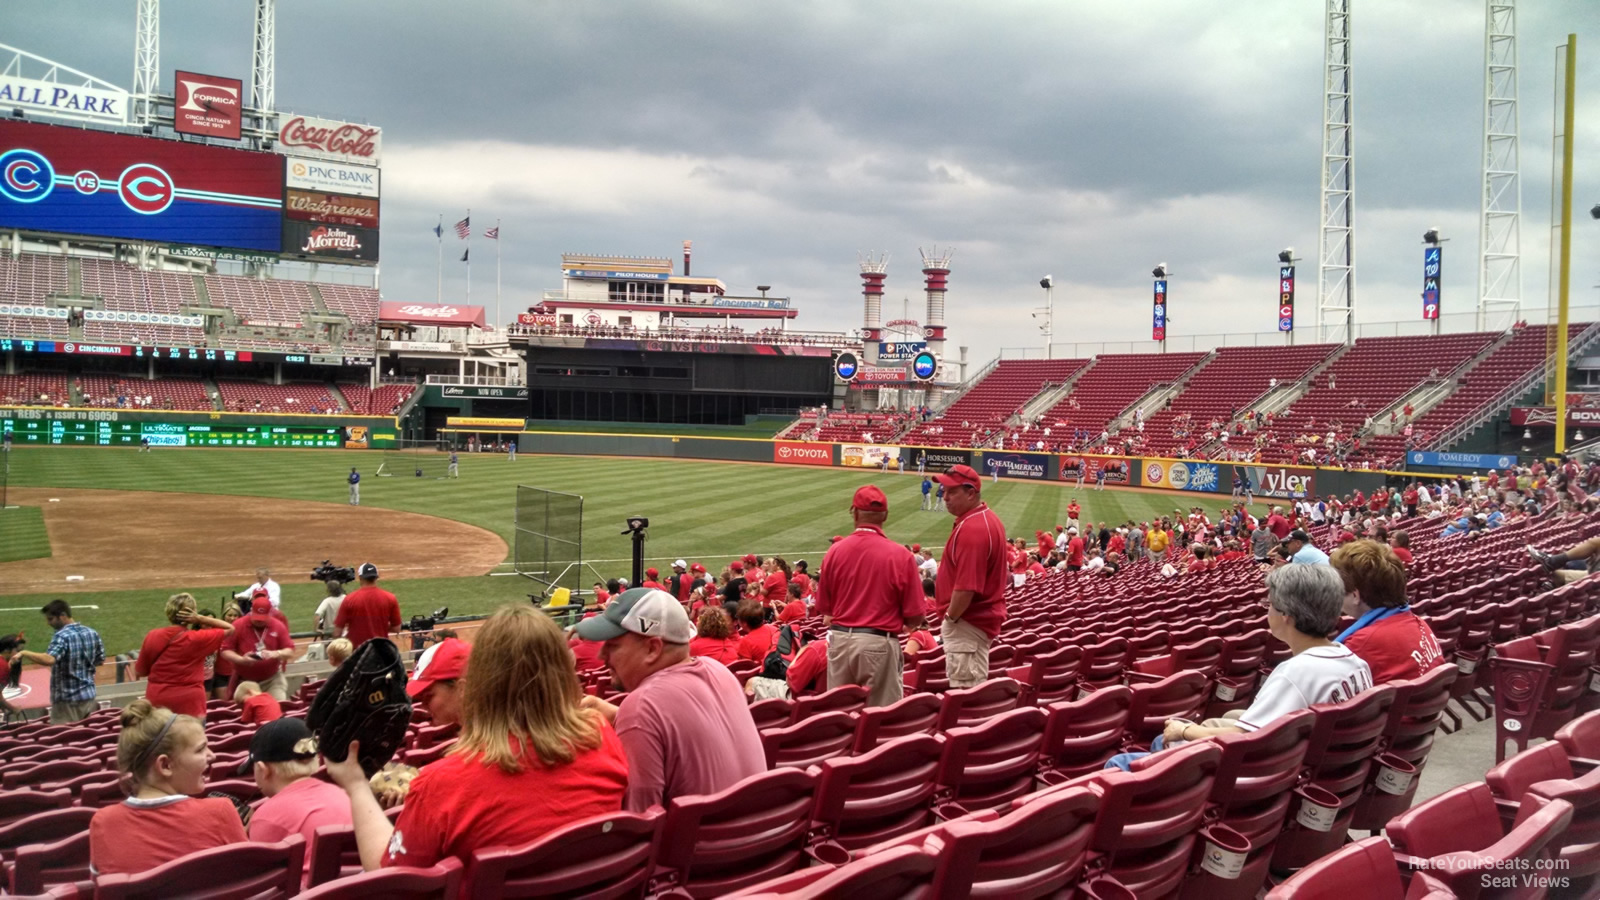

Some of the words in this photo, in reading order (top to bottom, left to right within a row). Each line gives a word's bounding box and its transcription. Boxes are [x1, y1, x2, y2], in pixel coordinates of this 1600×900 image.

[49, 87, 119, 114] PARK
[193, 93, 236, 105] FORMICA
[309, 166, 337, 179] PNC
[338, 169, 373, 184] BANK
[78, 177, 96, 188] VS
[289, 195, 374, 216] Walgreens
[324, 228, 346, 238] John
[302, 234, 361, 251] Morrell
[171, 248, 217, 258] ULTIMATE
[218, 252, 233, 260] AIR
[235, 254, 276, 263] SHUTTLE
[713, 297, 765, 309] Cincinnati
[768, 299, 787, 309] Bell
[398, 305, 459, 315] Reds
[79, 345, 121, 353] CINCINNATI
[896, 343, 917, 353] PNC
[477, 388, 489, 396] NOW
[490, 388, 503, 396] OPEN
[54, 411, 76, 419] ISSUE
[78, 411, 87, 420] TO
[88, 411, 118, 421] 69050
[793, 448, 828, 459] TOYOTA
[1438, 453, 1481, 463] POMEROY
[927, 455, 965, 463] HORSESHOE
[1008, 461, 1044, 471] AMERICAN
